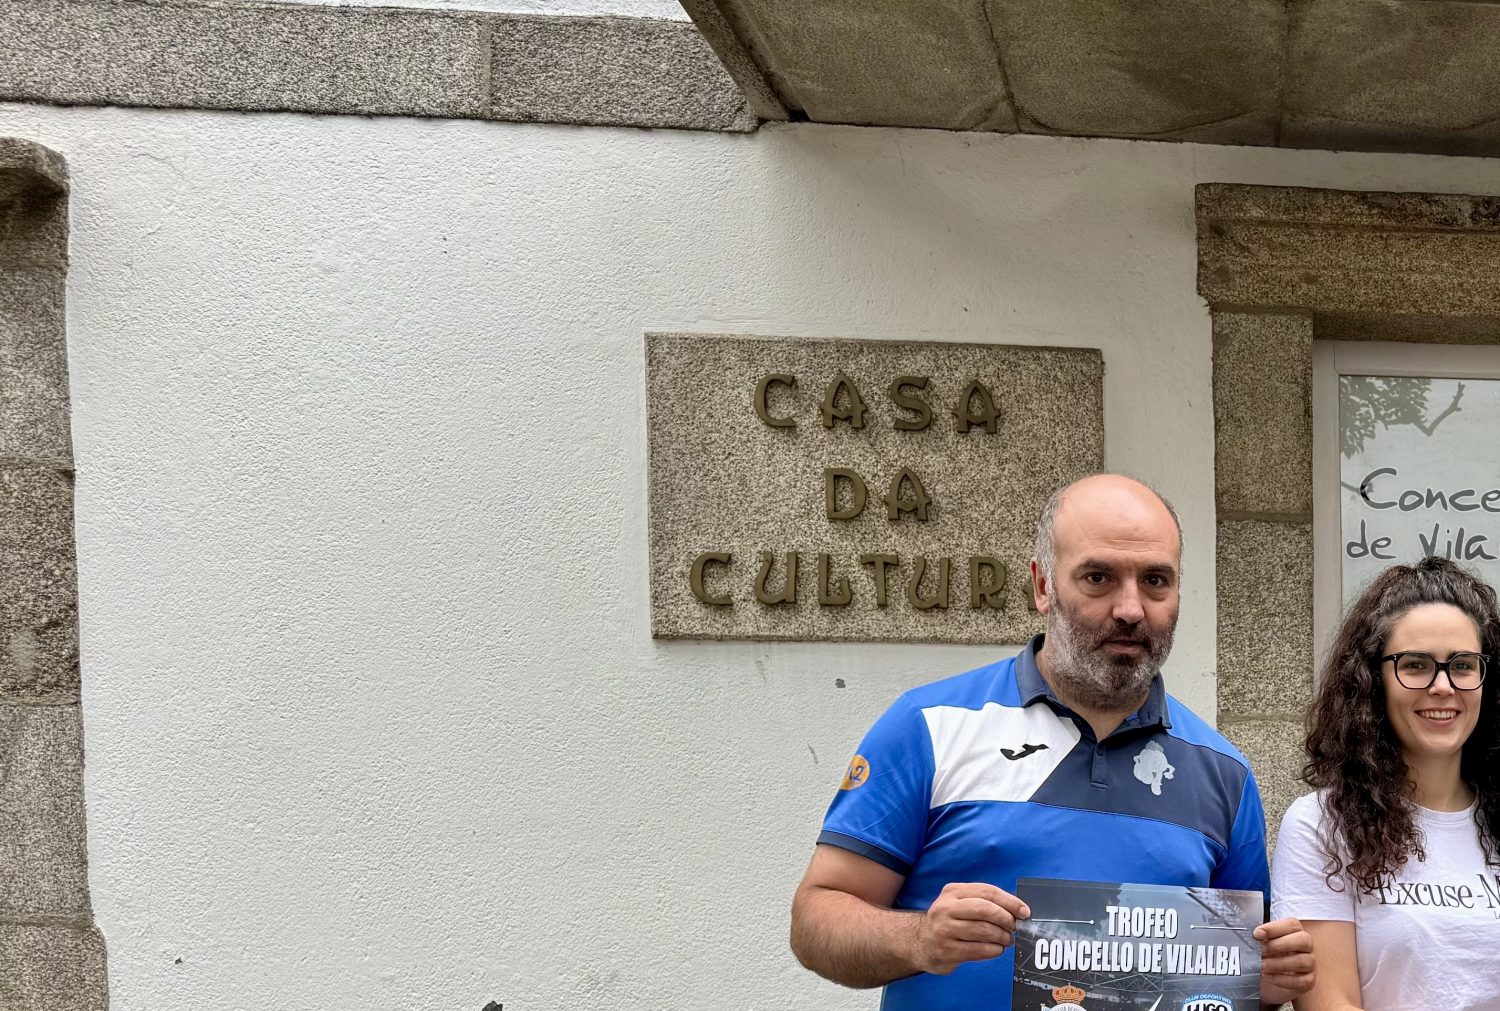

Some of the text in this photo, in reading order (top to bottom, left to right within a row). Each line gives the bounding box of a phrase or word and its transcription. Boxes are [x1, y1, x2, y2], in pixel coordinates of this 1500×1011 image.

[753, 370, 1000, 434] CASA
[824, 466, 933, 522] DA
[1346, 518, 1397, 559] de
[1105, 905, 1178, 939] TROFEO
[1034, 938, 1242, 976] CONCELLO DE VILALBA
